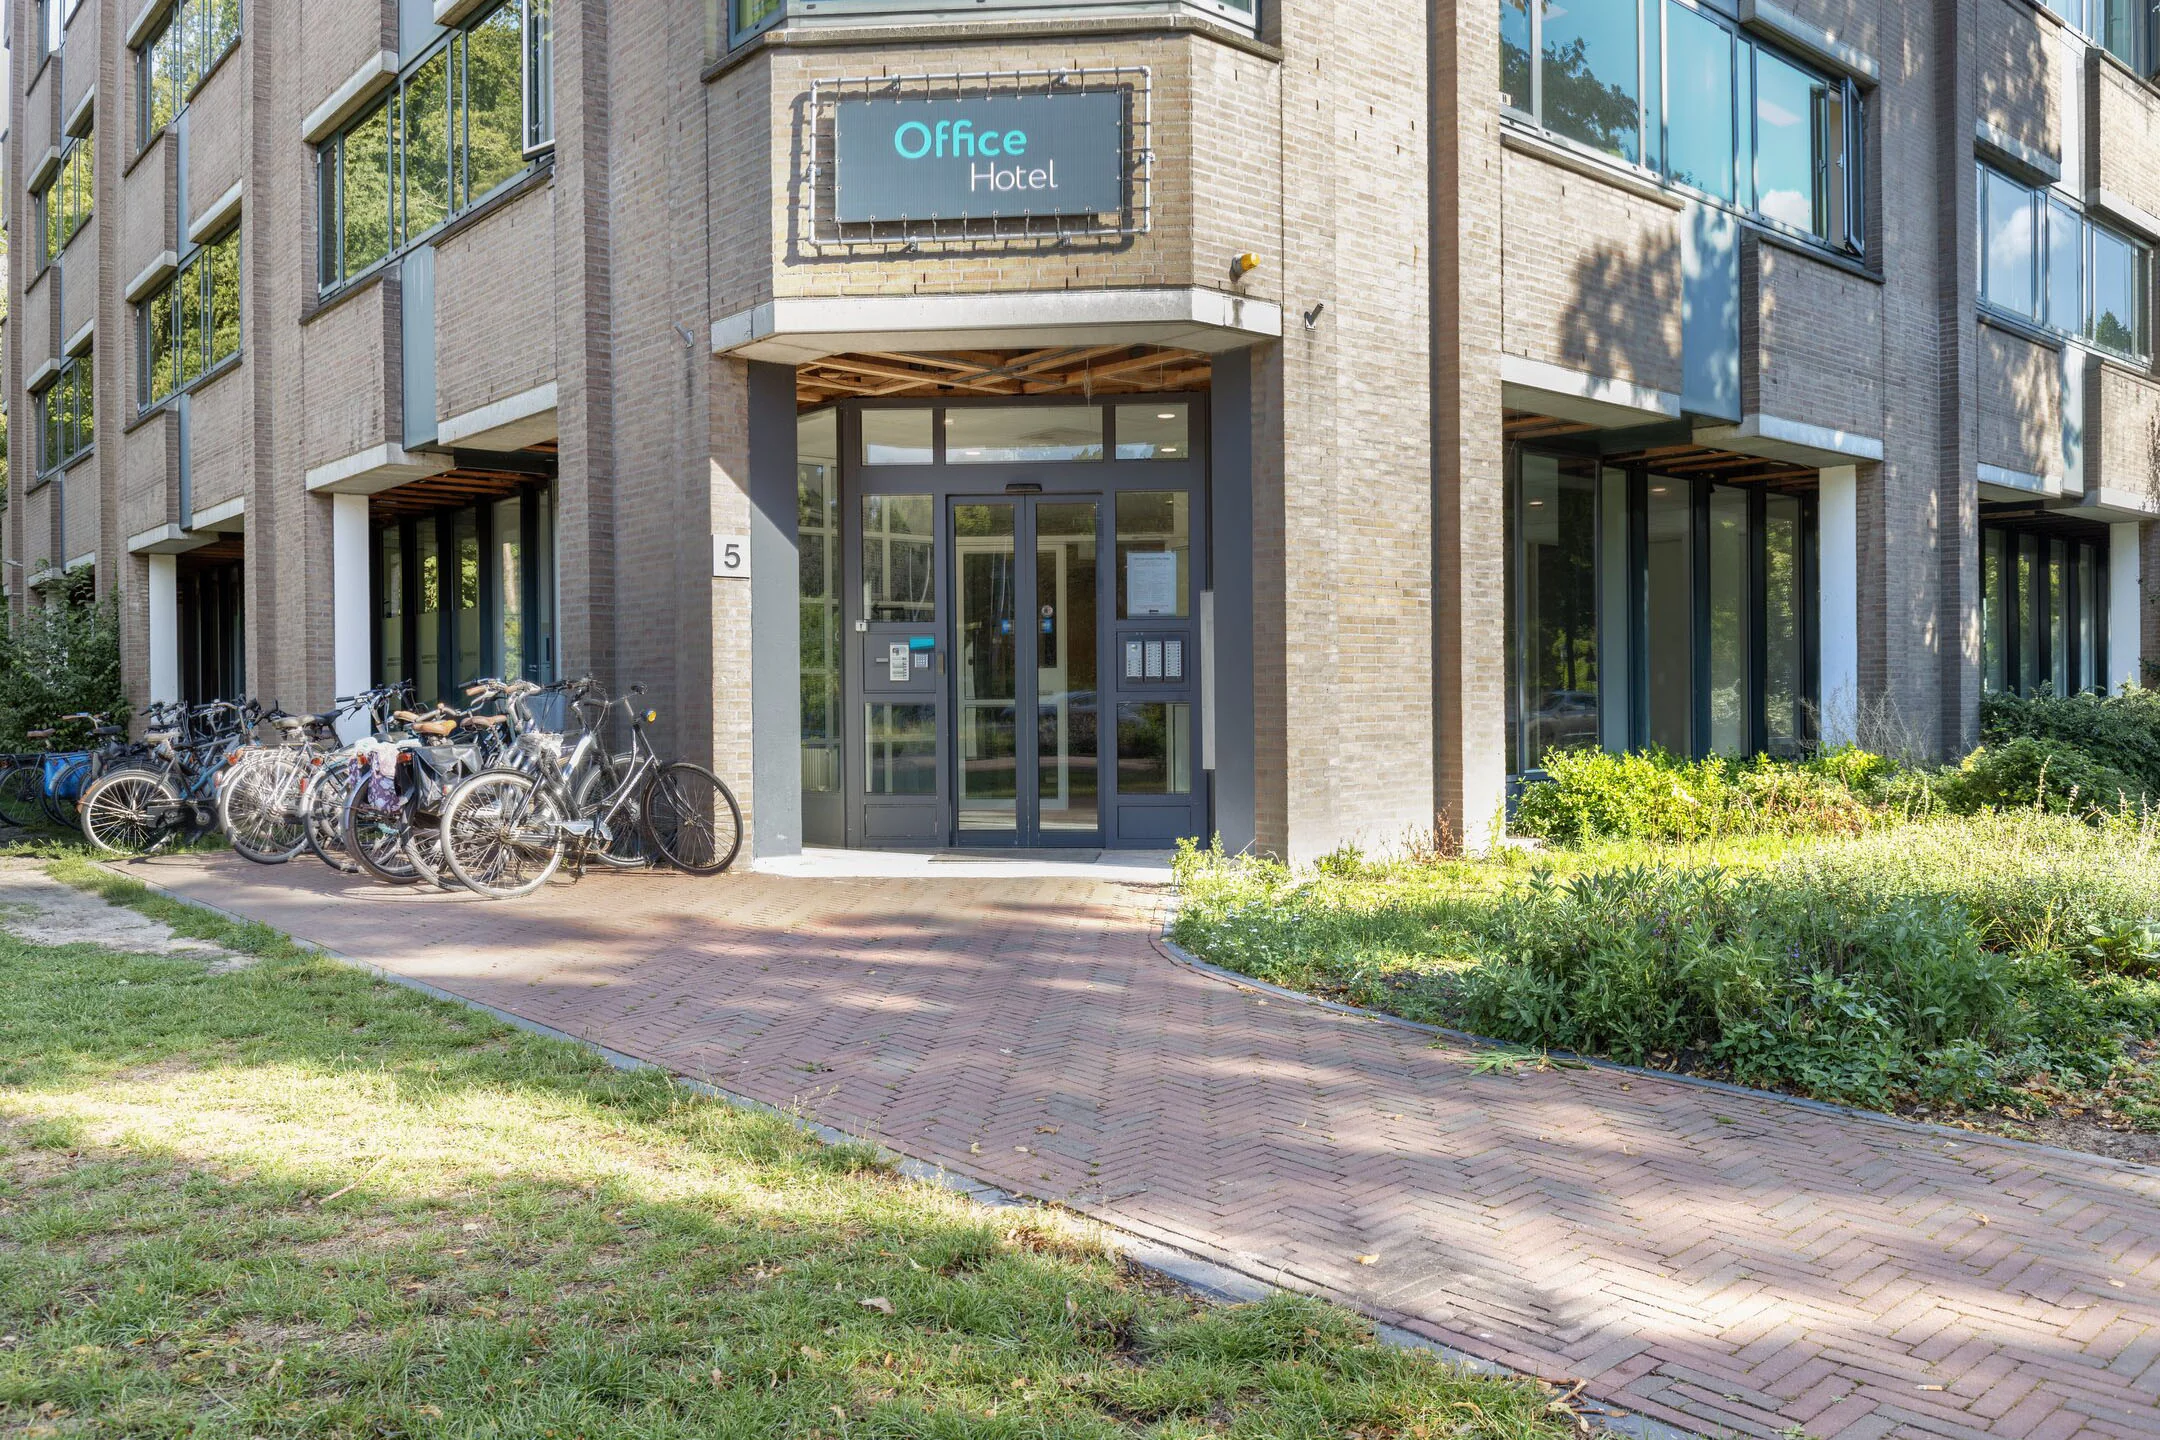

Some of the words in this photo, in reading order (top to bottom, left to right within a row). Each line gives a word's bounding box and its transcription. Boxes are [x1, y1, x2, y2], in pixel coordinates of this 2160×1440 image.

[894, 119, 1028, 159] Office
[970, 159, 1058, 192] Hotel
[723, 543, 742, 569] 5
